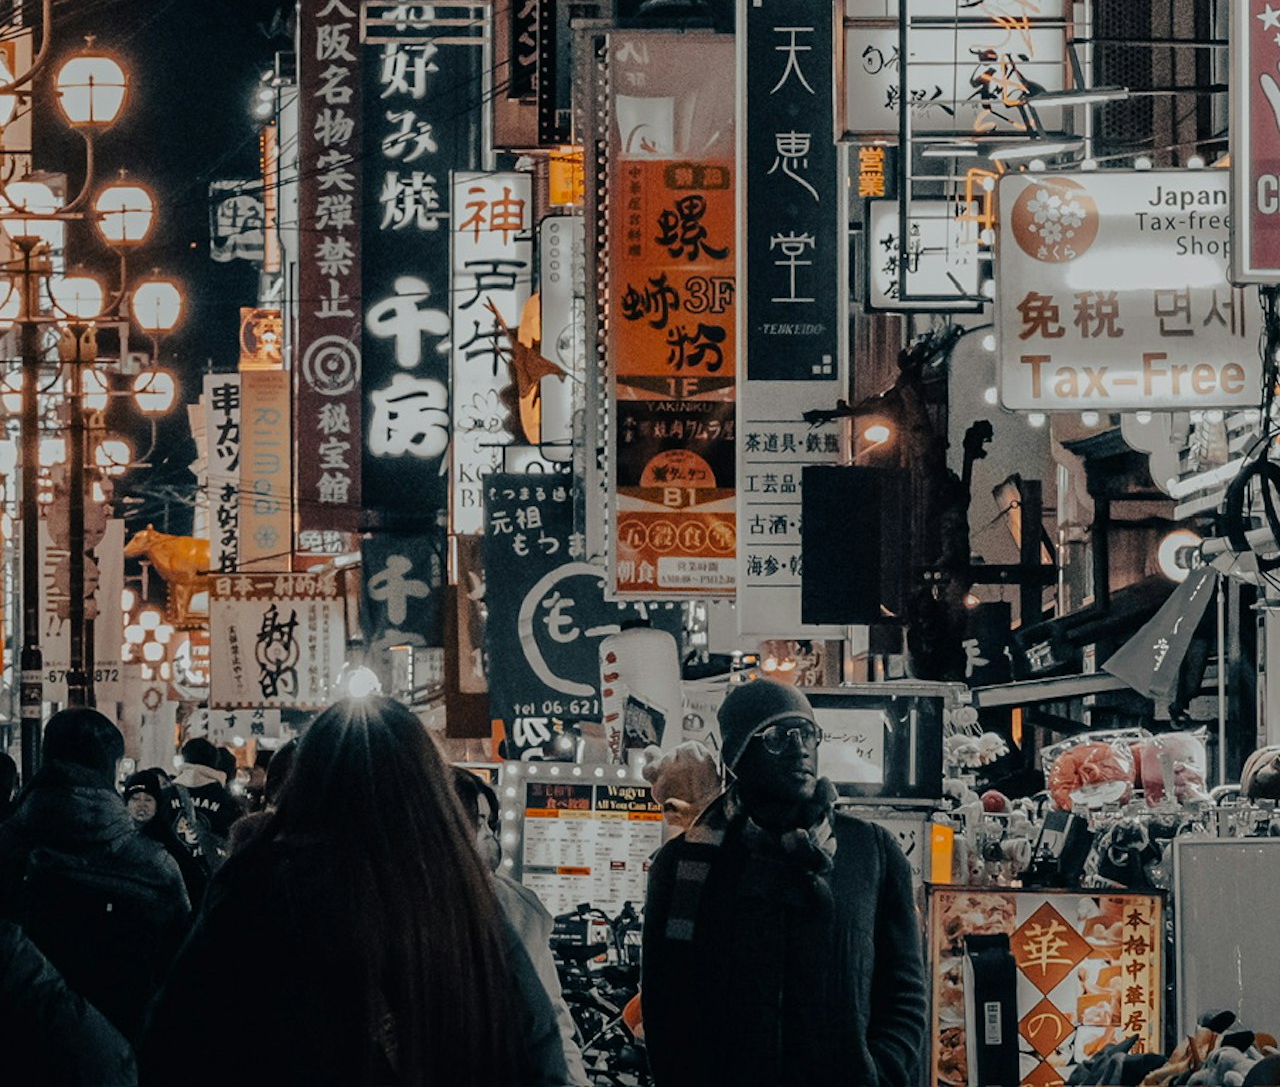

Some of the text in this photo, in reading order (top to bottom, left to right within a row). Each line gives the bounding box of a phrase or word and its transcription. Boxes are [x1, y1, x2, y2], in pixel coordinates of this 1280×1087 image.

[766, 24, 821, 304] 天恵堂
[1147, 185, 1229, 208] Japan
[1036, 246, 1077, 260] さくら
[457, 185, 529, 377] 神戸牛
[683, 276, 736, 315] 3F
[1015, 284, 1247, 341] 免税 면세
[365, 274, 451, 460] 千房
[1019, 351, 1247, 400] Tax-Free
[314, 402, 353, 504] 秘宝館
[662, 487, 698, 507] B1
[490, 505, 544, 536] 元祖
[748, 514, 802, 536] 古酒・
[255, 603, 300, 699] 射的
[597, 799, 609, 810] All
[610, 799, 628, 811] You
[628, 800, 647, 811] Can
[607, 785, 646, 800] Wagyu
